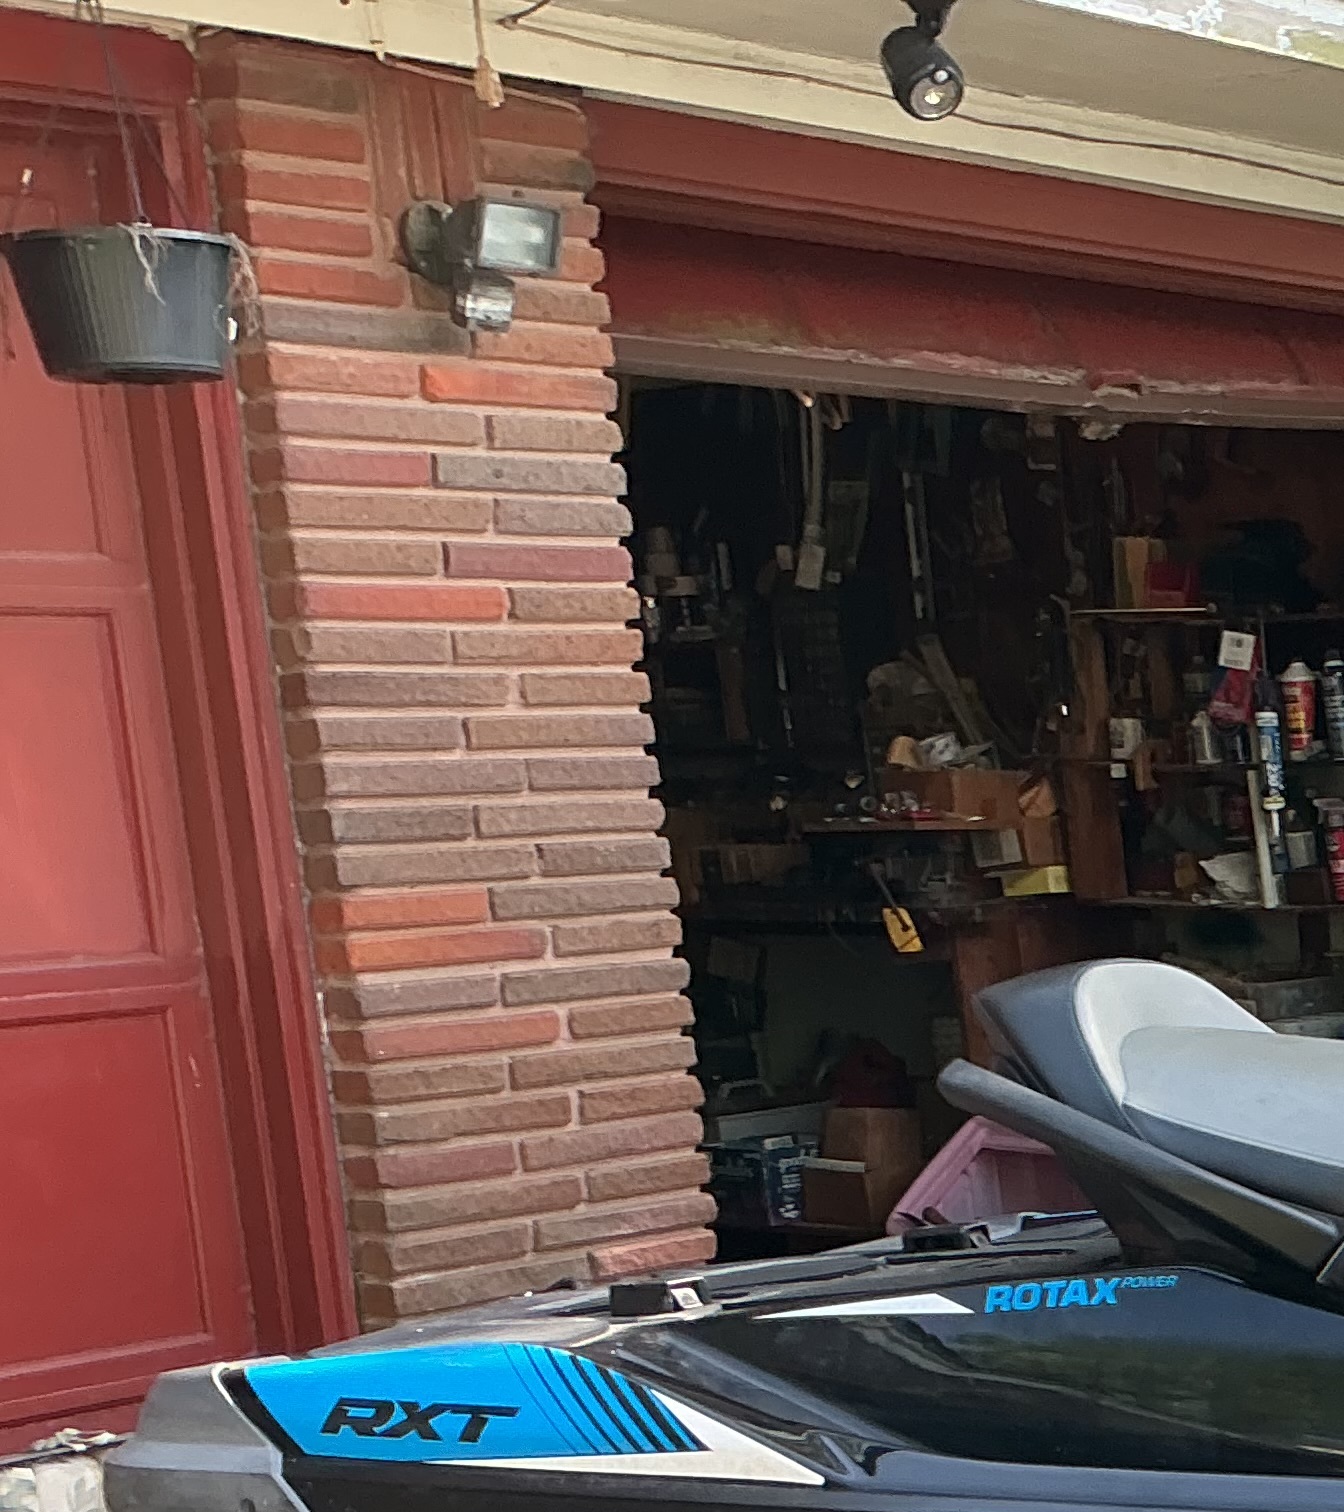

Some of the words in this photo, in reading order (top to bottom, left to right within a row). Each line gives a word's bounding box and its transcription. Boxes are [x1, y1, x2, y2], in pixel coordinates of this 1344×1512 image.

[984, 1277, 1121, 1314] ROTAX
[1119, 1274, 1179, 1289] POWER
[320, 1397, 520, 1442] RXT
